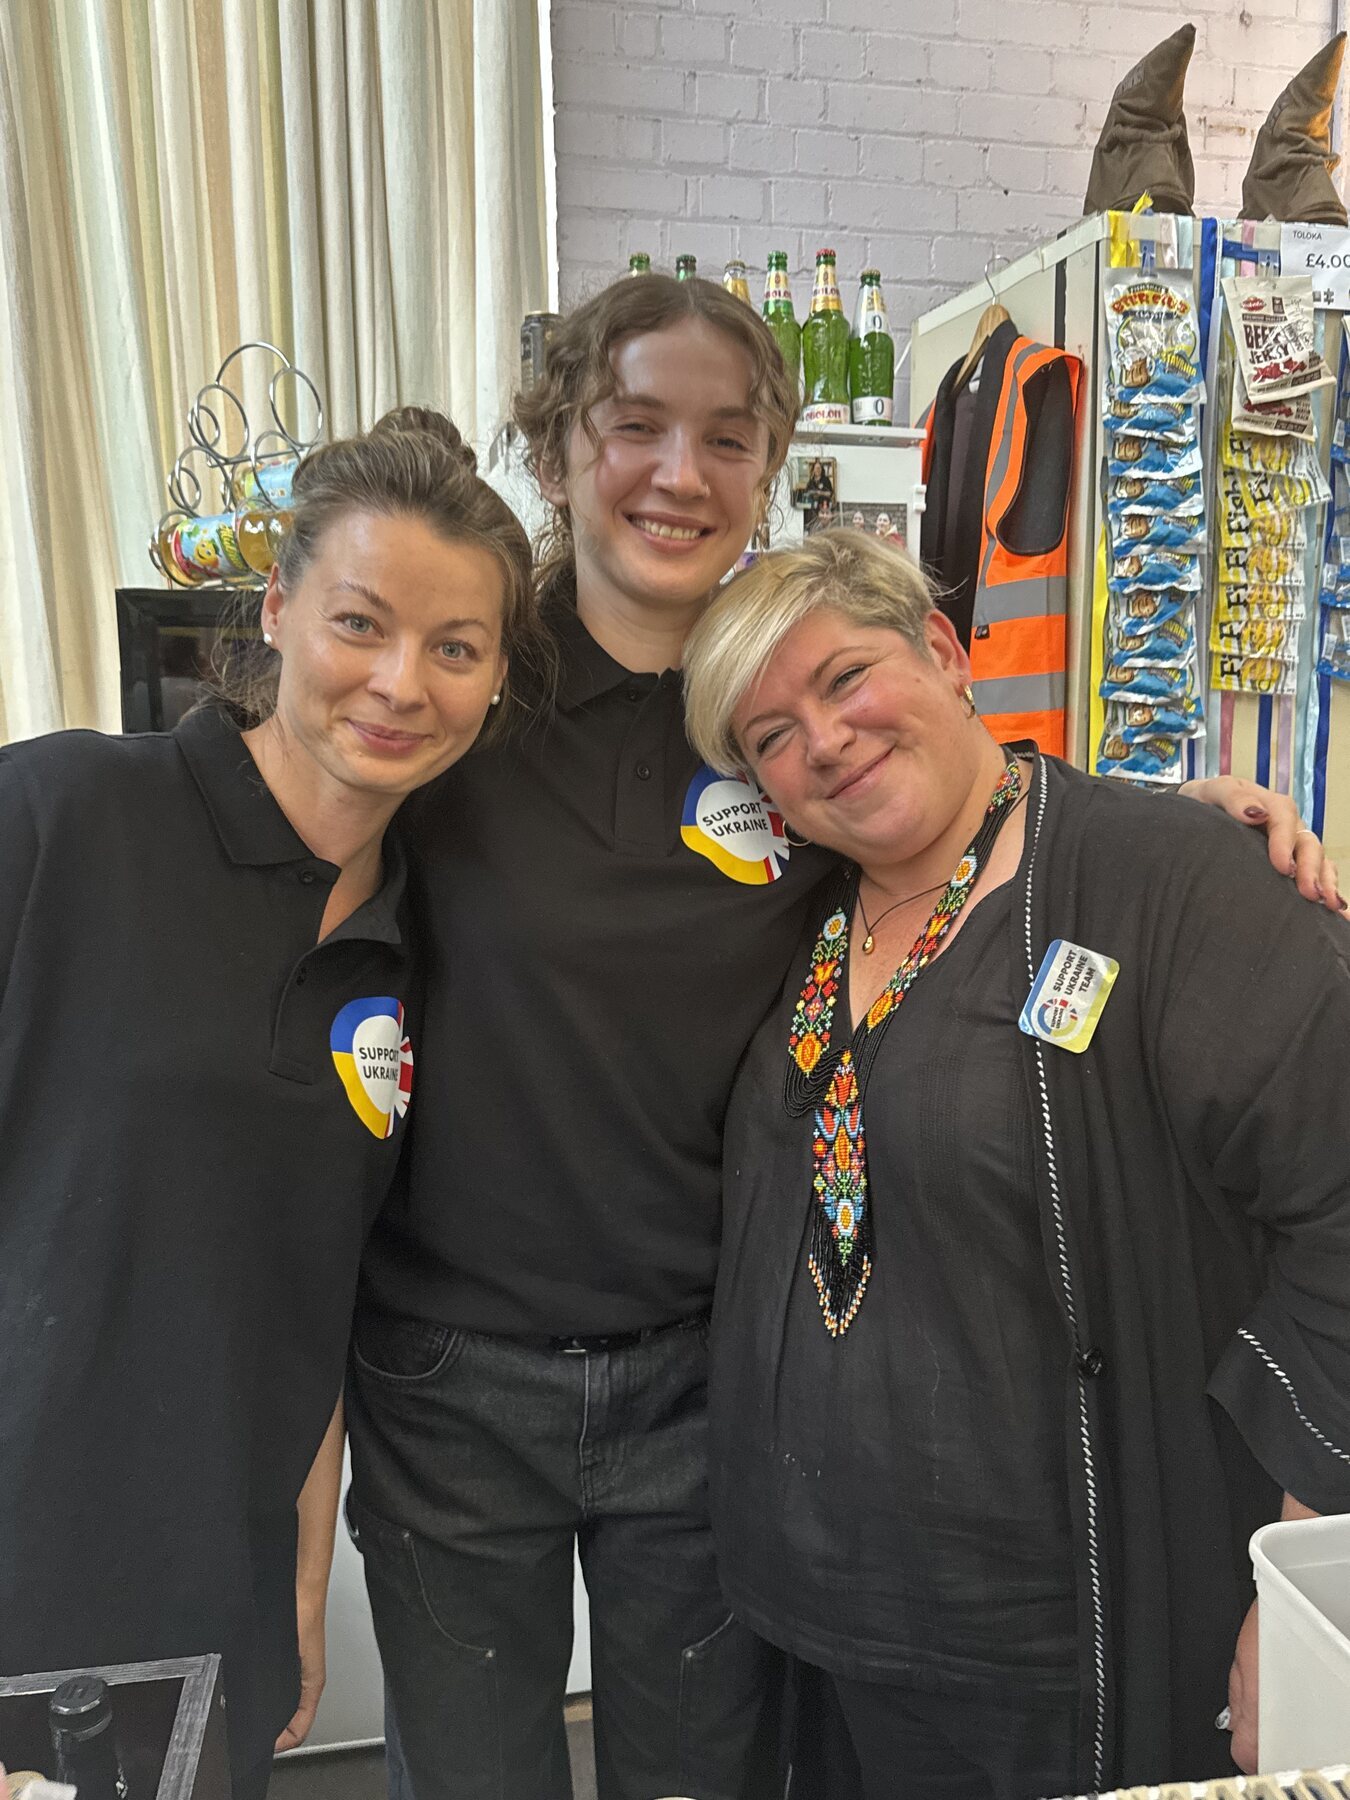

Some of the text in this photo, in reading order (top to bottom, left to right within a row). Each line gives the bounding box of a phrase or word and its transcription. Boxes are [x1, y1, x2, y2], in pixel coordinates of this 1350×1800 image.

[1293, 230, 1322, 240] TOLOKA
[703, 802, 762, 826] SUPPORT
[712, 819, 768, 837] UKRAINE
[1053, 950, 1077, 992] SUPPORT
[1065, 955, 1088, 995] UKRAINE
[1078, 967, 1096, 992] TEAM
[359, 1047, 399, 1062] SUPPORT
[363, 1065, 399, 1081] UKRAINE
